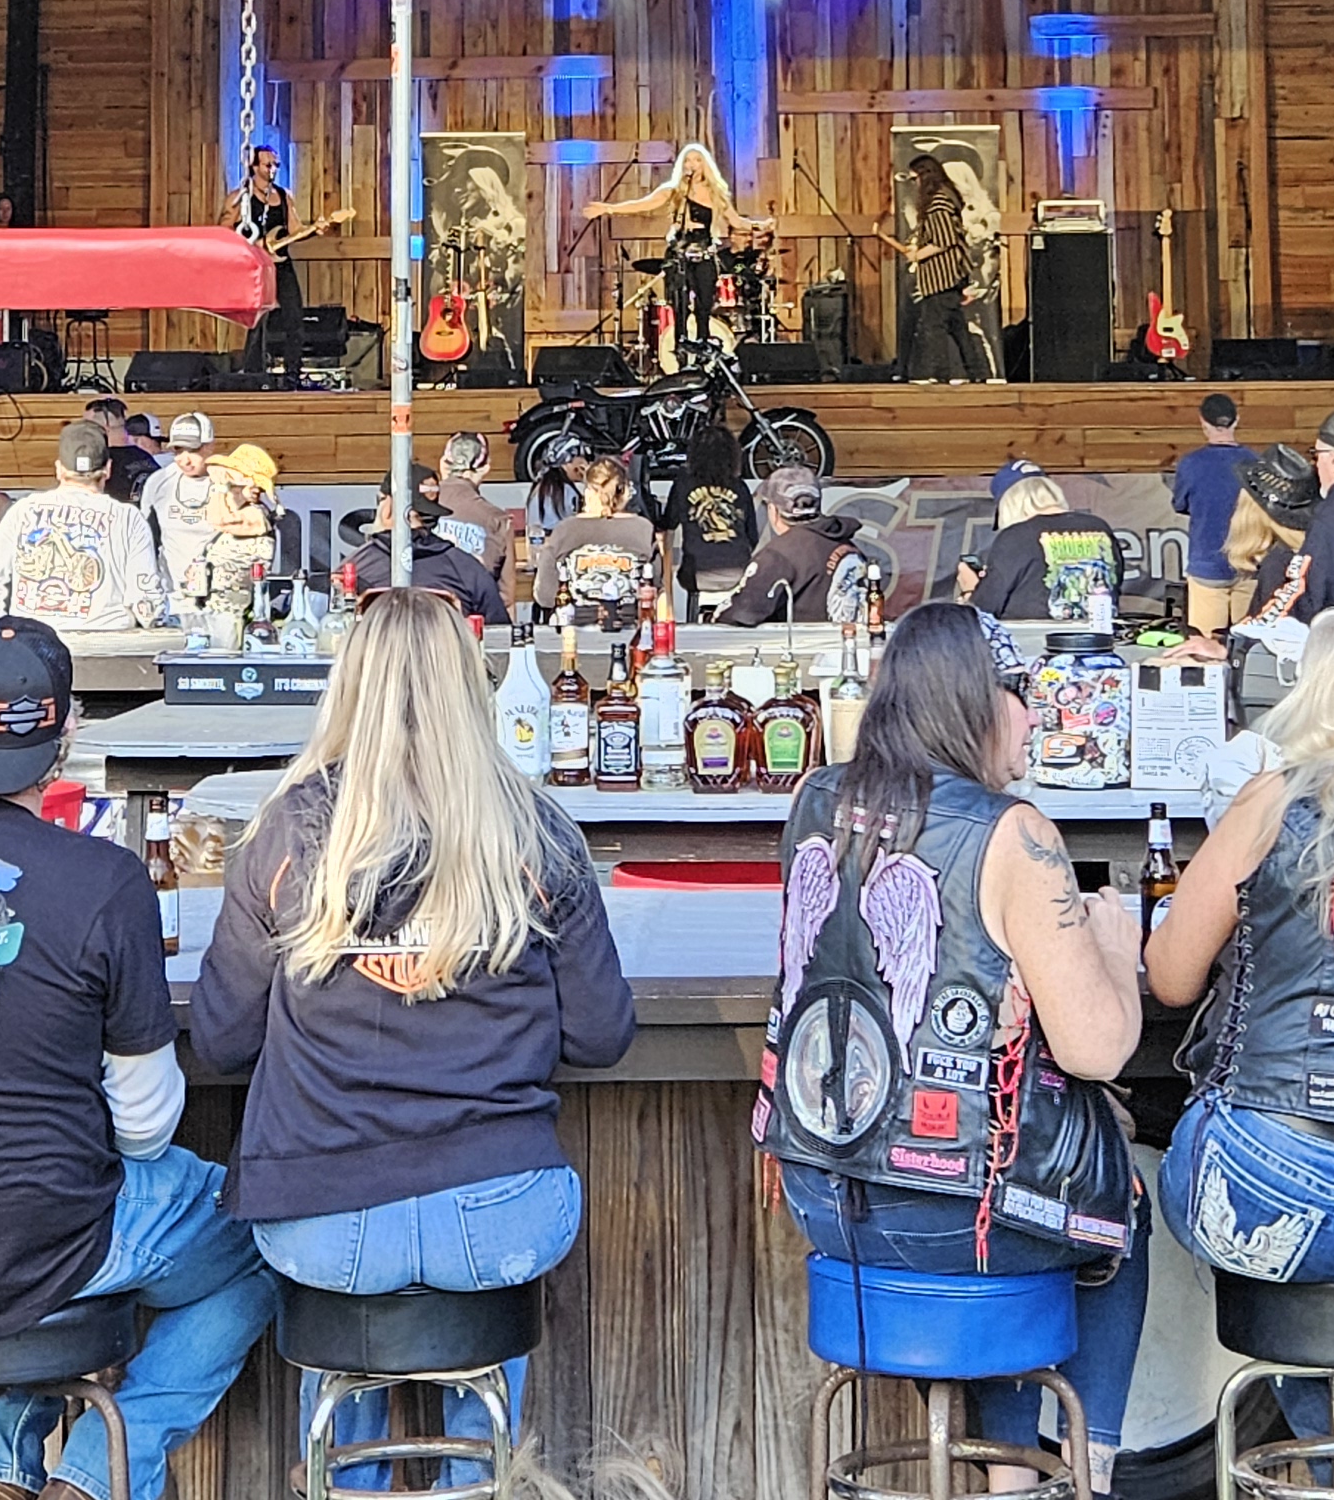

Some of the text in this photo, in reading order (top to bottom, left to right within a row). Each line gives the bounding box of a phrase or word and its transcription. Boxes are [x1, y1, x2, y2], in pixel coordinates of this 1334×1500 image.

[18, 502, 111, 538] STURGIS
[926, 1053, 978, 1073] FUCK YOU
[945, 1069, 968, 1082] LOT
[890, 1146, 966, 1174] Sisterhood
